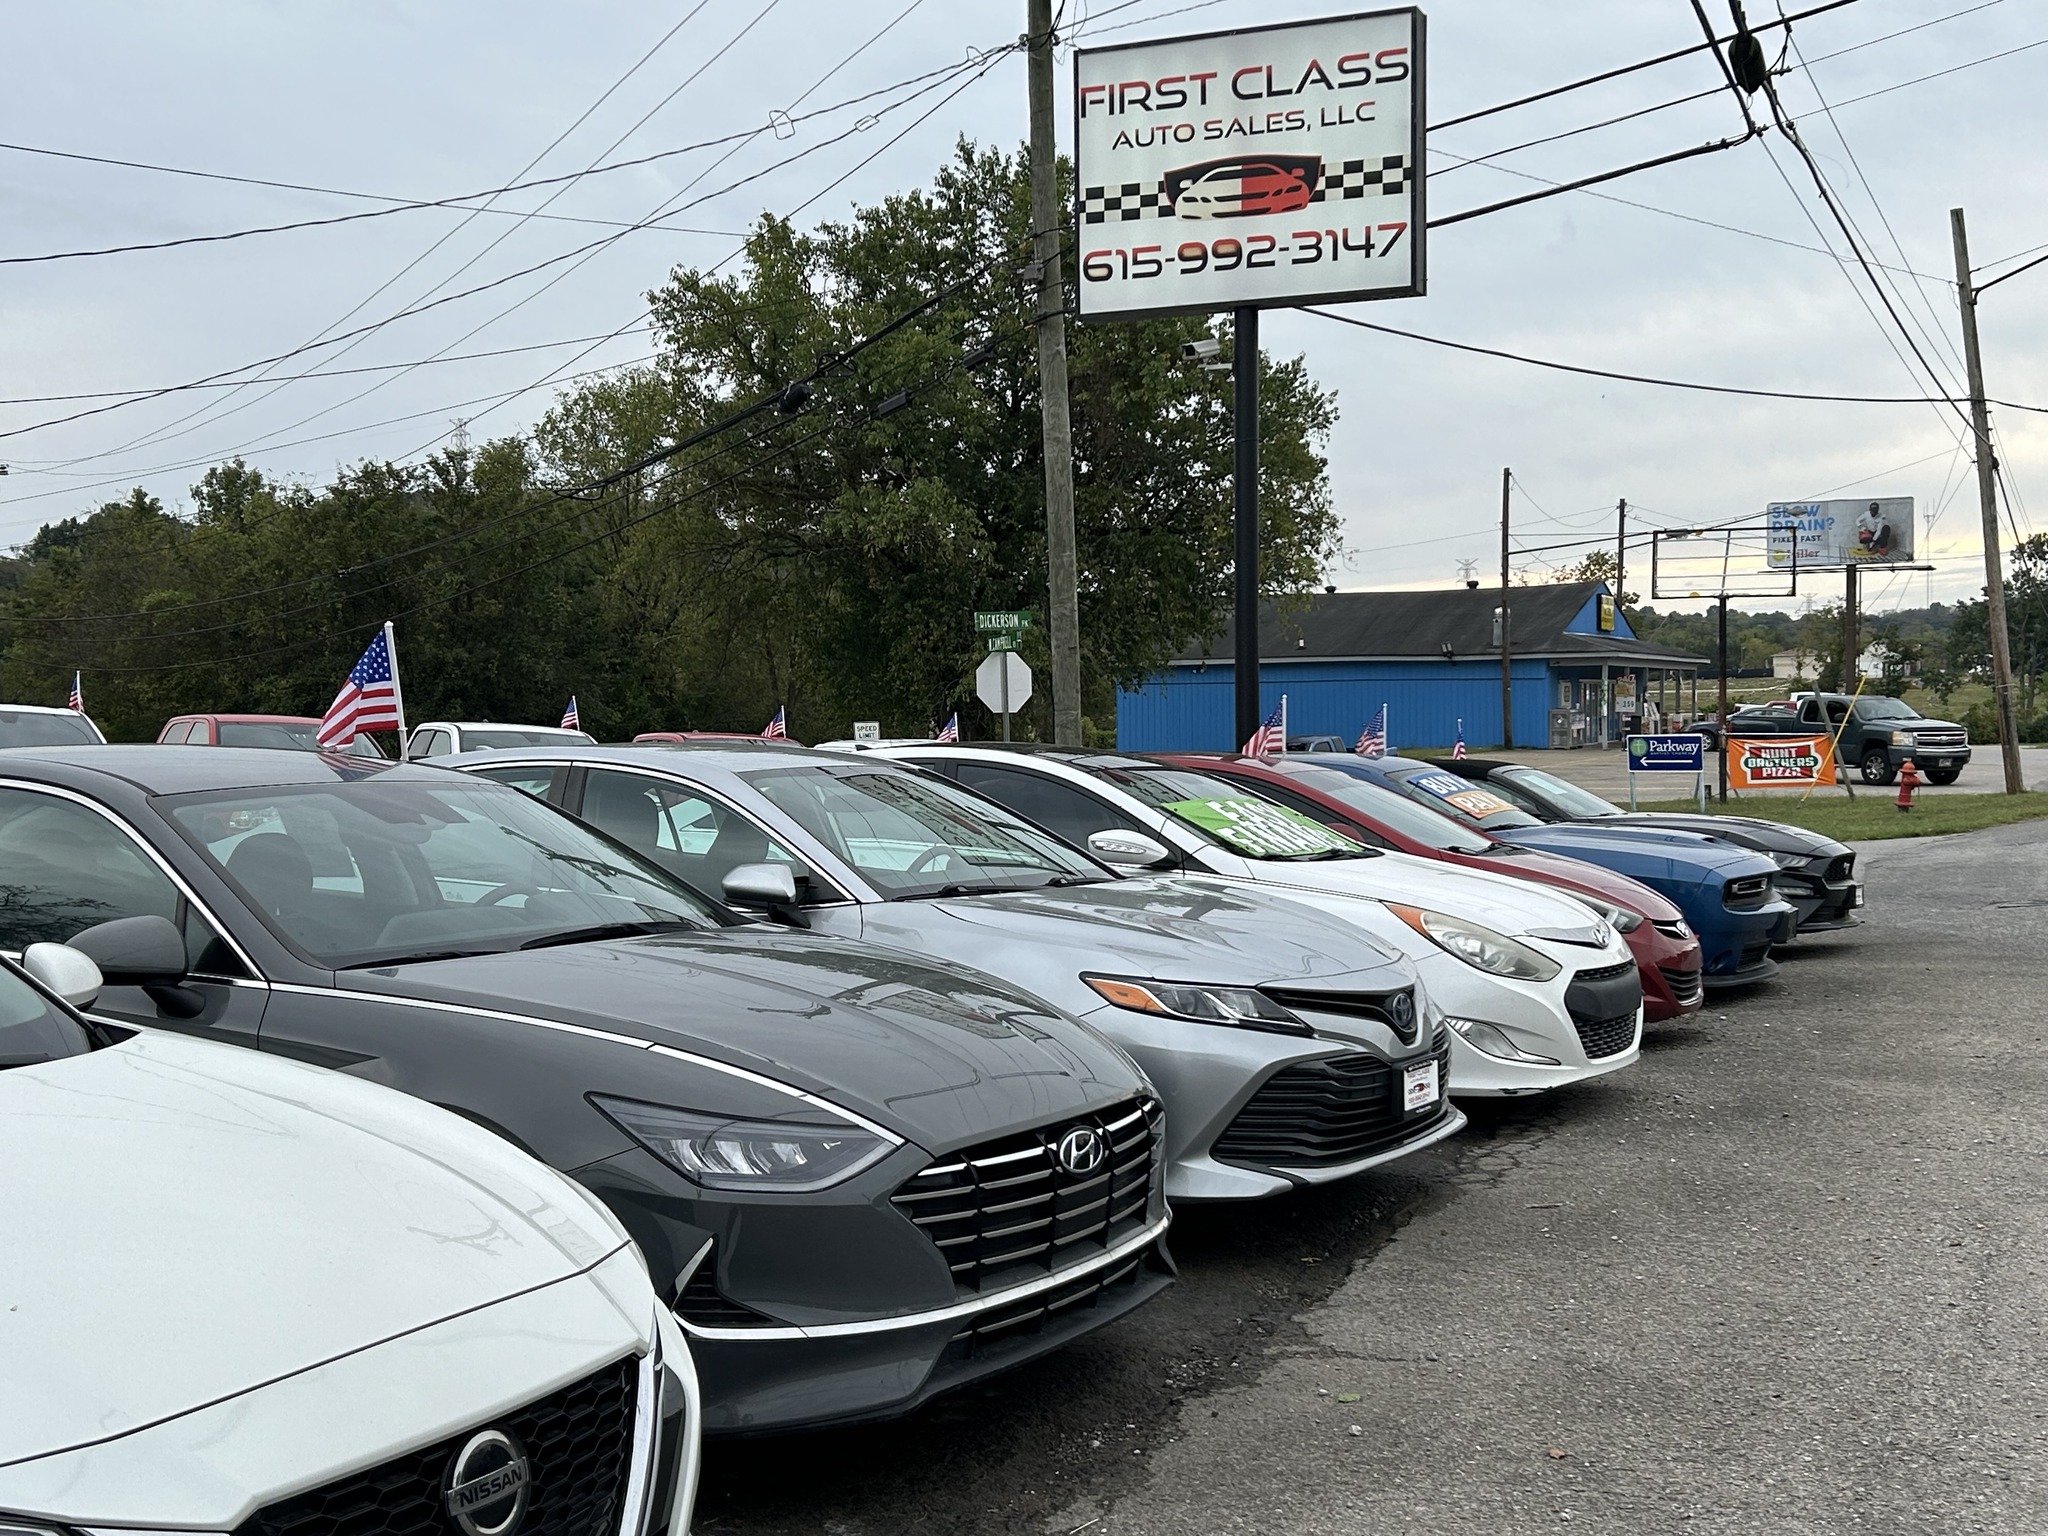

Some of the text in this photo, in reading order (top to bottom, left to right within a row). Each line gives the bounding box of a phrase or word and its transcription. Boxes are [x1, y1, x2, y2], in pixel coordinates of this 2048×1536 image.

[1080, 48, 1409, 119] FIRST CLASS
[1112, 101, 1376, 150] AUTO SALES, LLC
[1082, 222, 1408, 283] 615-992-3147
[1772, 517, 1835, 533] DRAIN?
[1801, 534, 1824, 542] FAST.
[980, 614, 1019, 628] DICKERSON
[1649, 739, 1700, 755] Parkway
[1760, 748, 1798, 759] HUNT
[1747, 757, 1815, 767] BROTHERS
[1761, 767, 1802, 777] PIZZA
[1418, 774, 1466, 795] BUY
[1453, 792, 1499, 813] PAY
[1204, 800, 1301, 830] EASY
[459, 1465, 522, 1508] NISSAN
